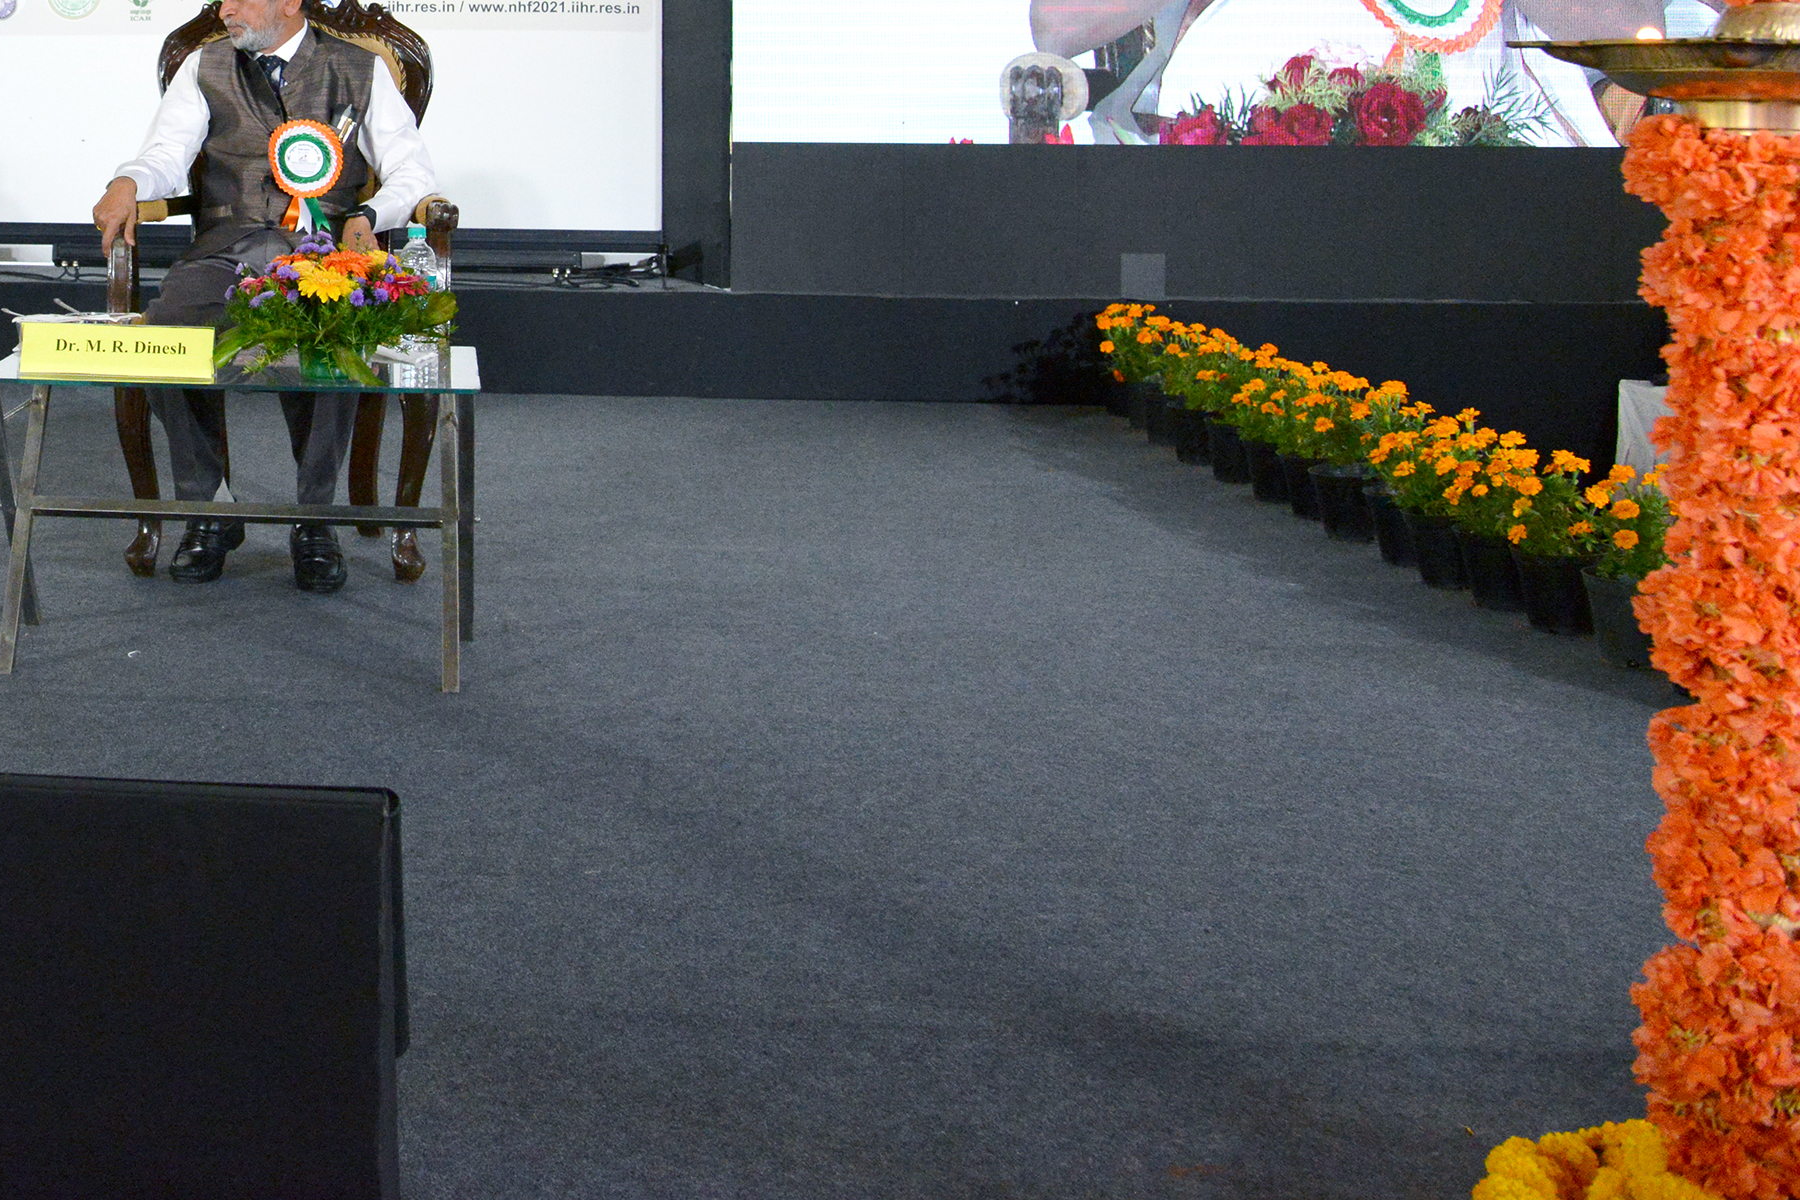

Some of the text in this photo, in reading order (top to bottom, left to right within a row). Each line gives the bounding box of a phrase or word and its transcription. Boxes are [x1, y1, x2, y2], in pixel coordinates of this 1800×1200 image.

[468, 0, 641, 15] www.nhf2021.iihr.res.in
[55, 337, 188, 356] Dr. M. R. Dinesh
